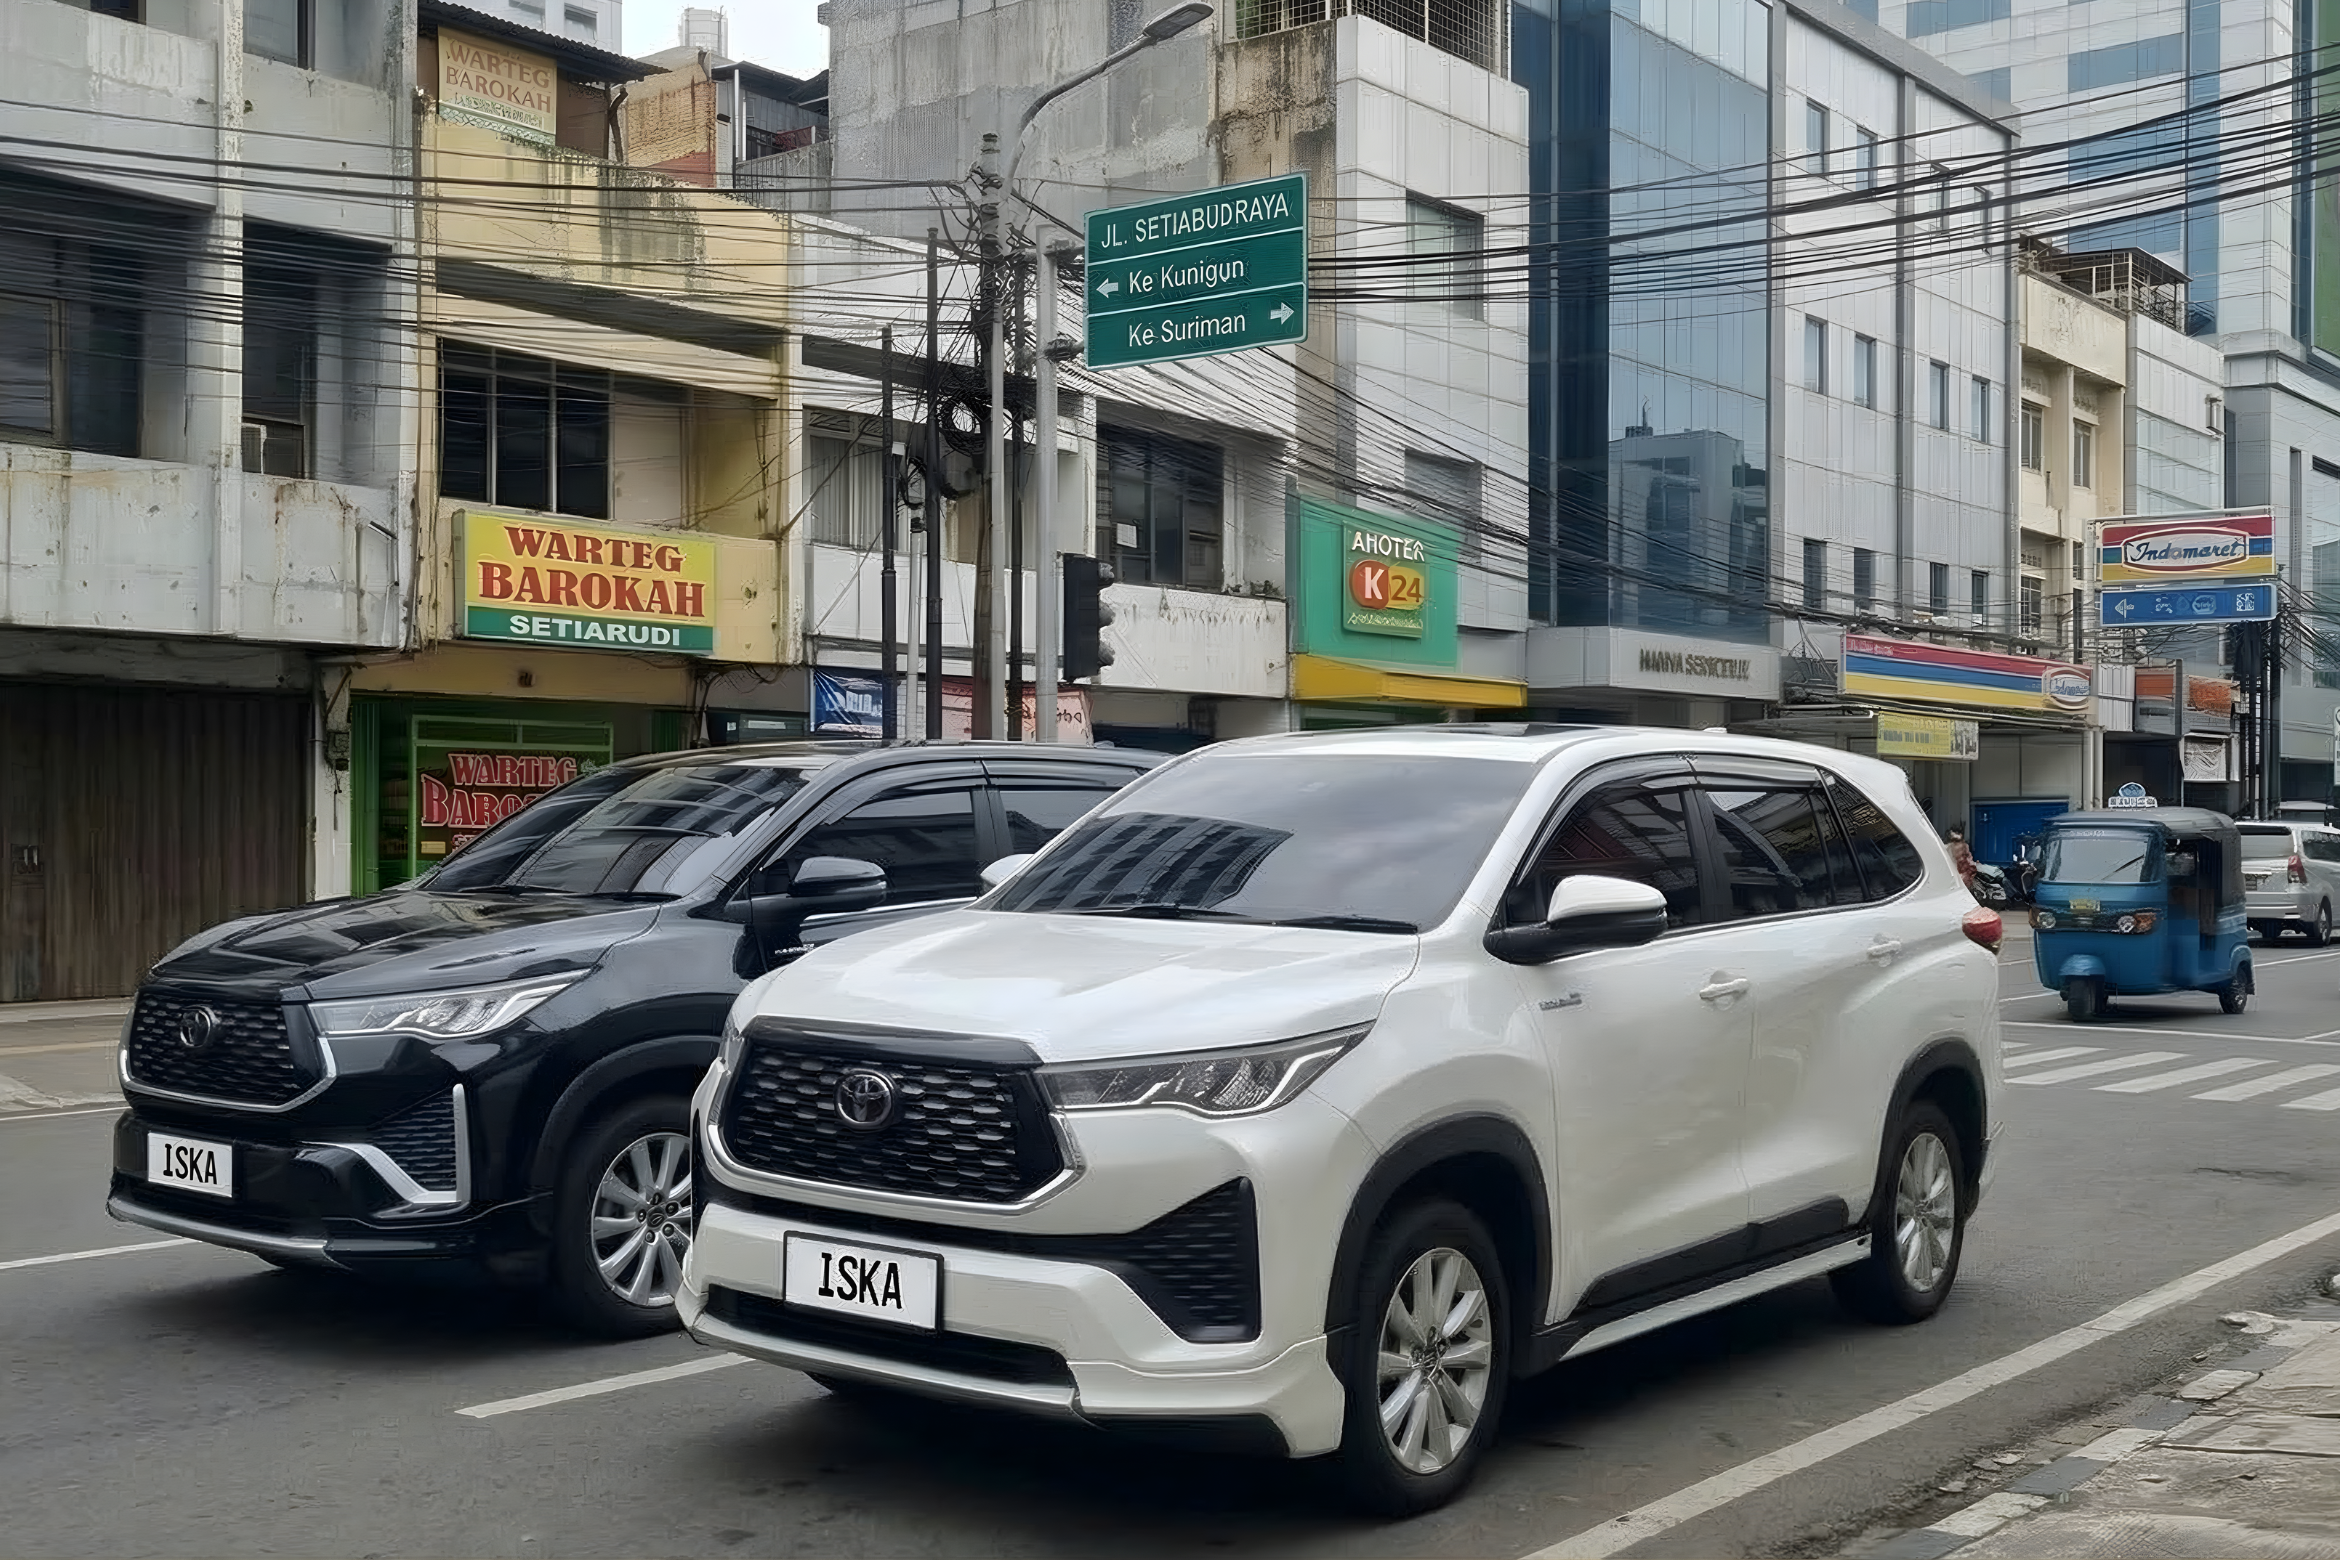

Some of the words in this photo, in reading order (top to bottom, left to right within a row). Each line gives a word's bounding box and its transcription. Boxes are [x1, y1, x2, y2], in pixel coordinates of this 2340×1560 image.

[449, 40, 550, 88] WARTEG
[446, 66, 551, 113] BAROKAH
[1101, 223, 1127, 248] JL.
[1135, 193, 1289, 243] SETIABUDRAYA
[1129, 270, 1153, 294] Ke
[1161, 259, 1244, 288] Kunigun
[1129, 323, 1154, 347] Ke
[1161, 313, 1246, 343] Suriman
[503, 525, 685, 573] WARTEG
[478, 561, 706, 617] BAROKAH
[509, 615, 680, 646] SETIARUDI
[448, 753, 578, 787] WARTEG
[421, 773, 545, 829] BARO
[163, 1143, 218, 1185] ISKA
[818, 1252, 903, 1310] ISKA
